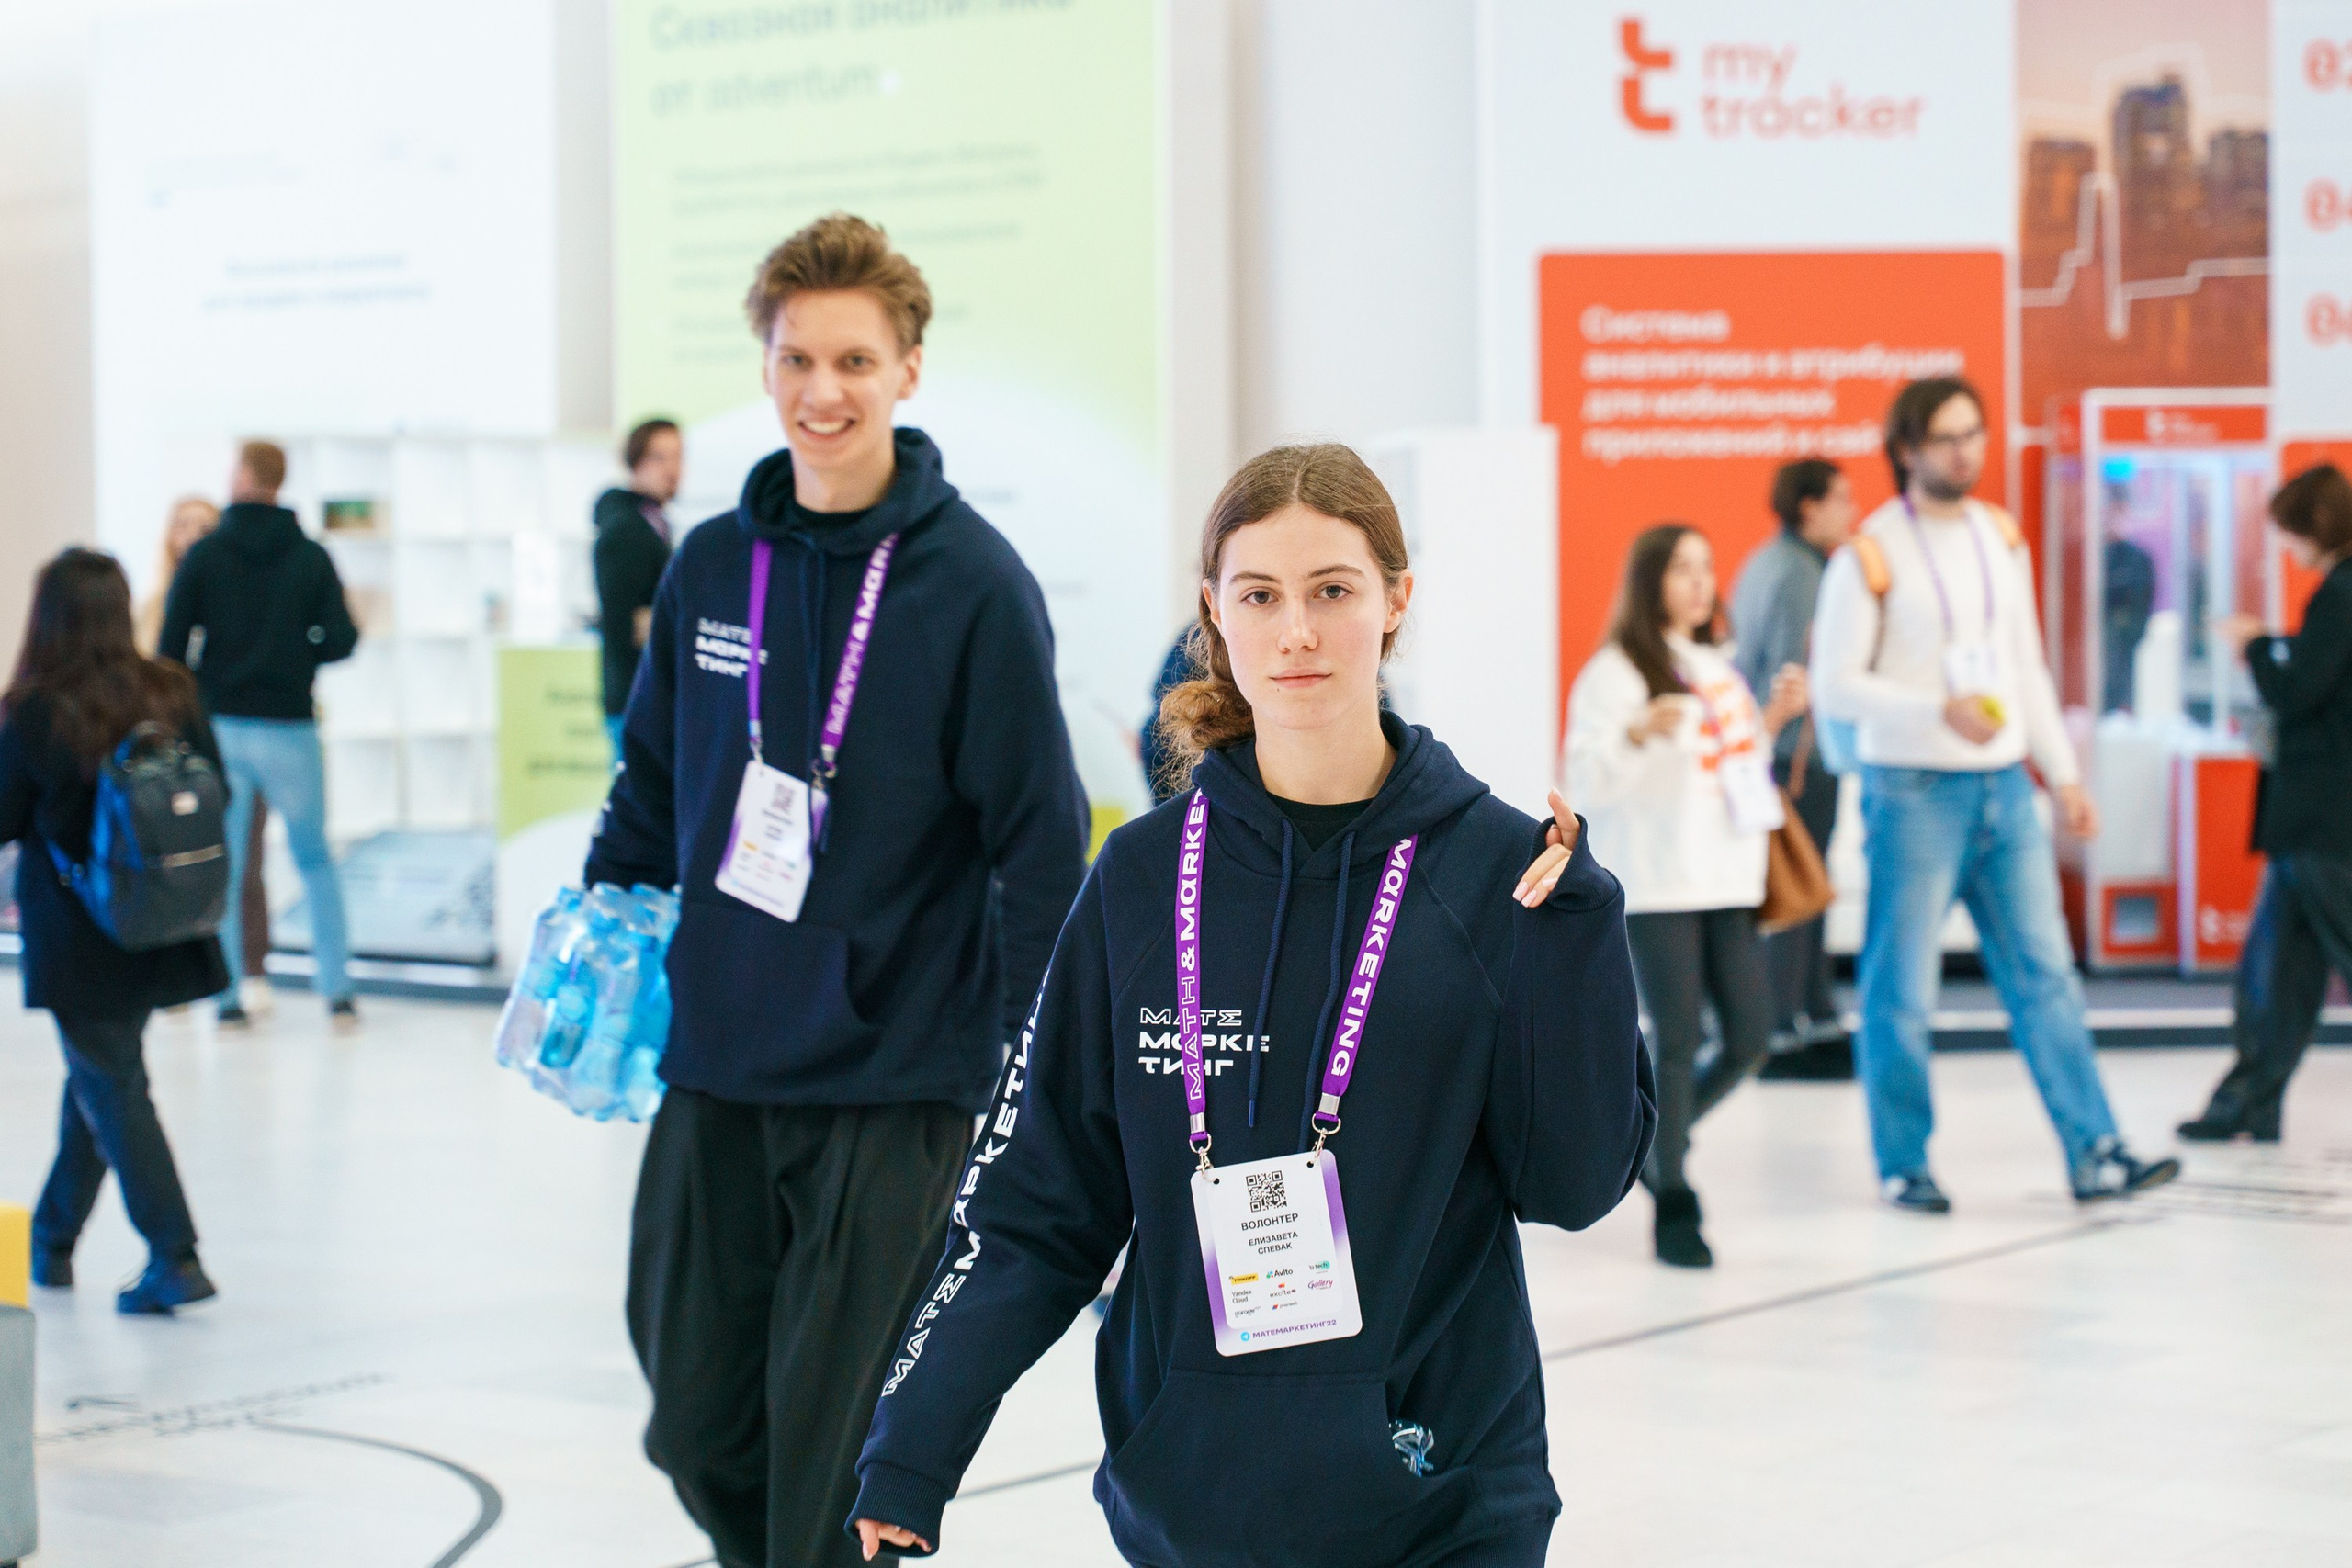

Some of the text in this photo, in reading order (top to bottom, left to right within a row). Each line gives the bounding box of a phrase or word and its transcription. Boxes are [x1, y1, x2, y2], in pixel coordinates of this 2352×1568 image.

[1702, 43, 1796, 91] my
[1181, 945, 1196, 972] &
[1139, 1007, 1242, 1026] МТЕ
[1181, 976, 1202, 1100] MATH
[1241, 1213, 1298, 1231] ВОЛОНТЕР
[1248, 1231, 1298, 1247] ЕЛИЗАВЕТА
[1257, 1242, 1293, 1255] СПЕВАК
[1274, 1268, 1294, 1277] Avito
[1307, 1279, 1334, 1290] Gallery
[1252, 1319, 1337, 1337] МАТЕМАРКЕТИНГ22
